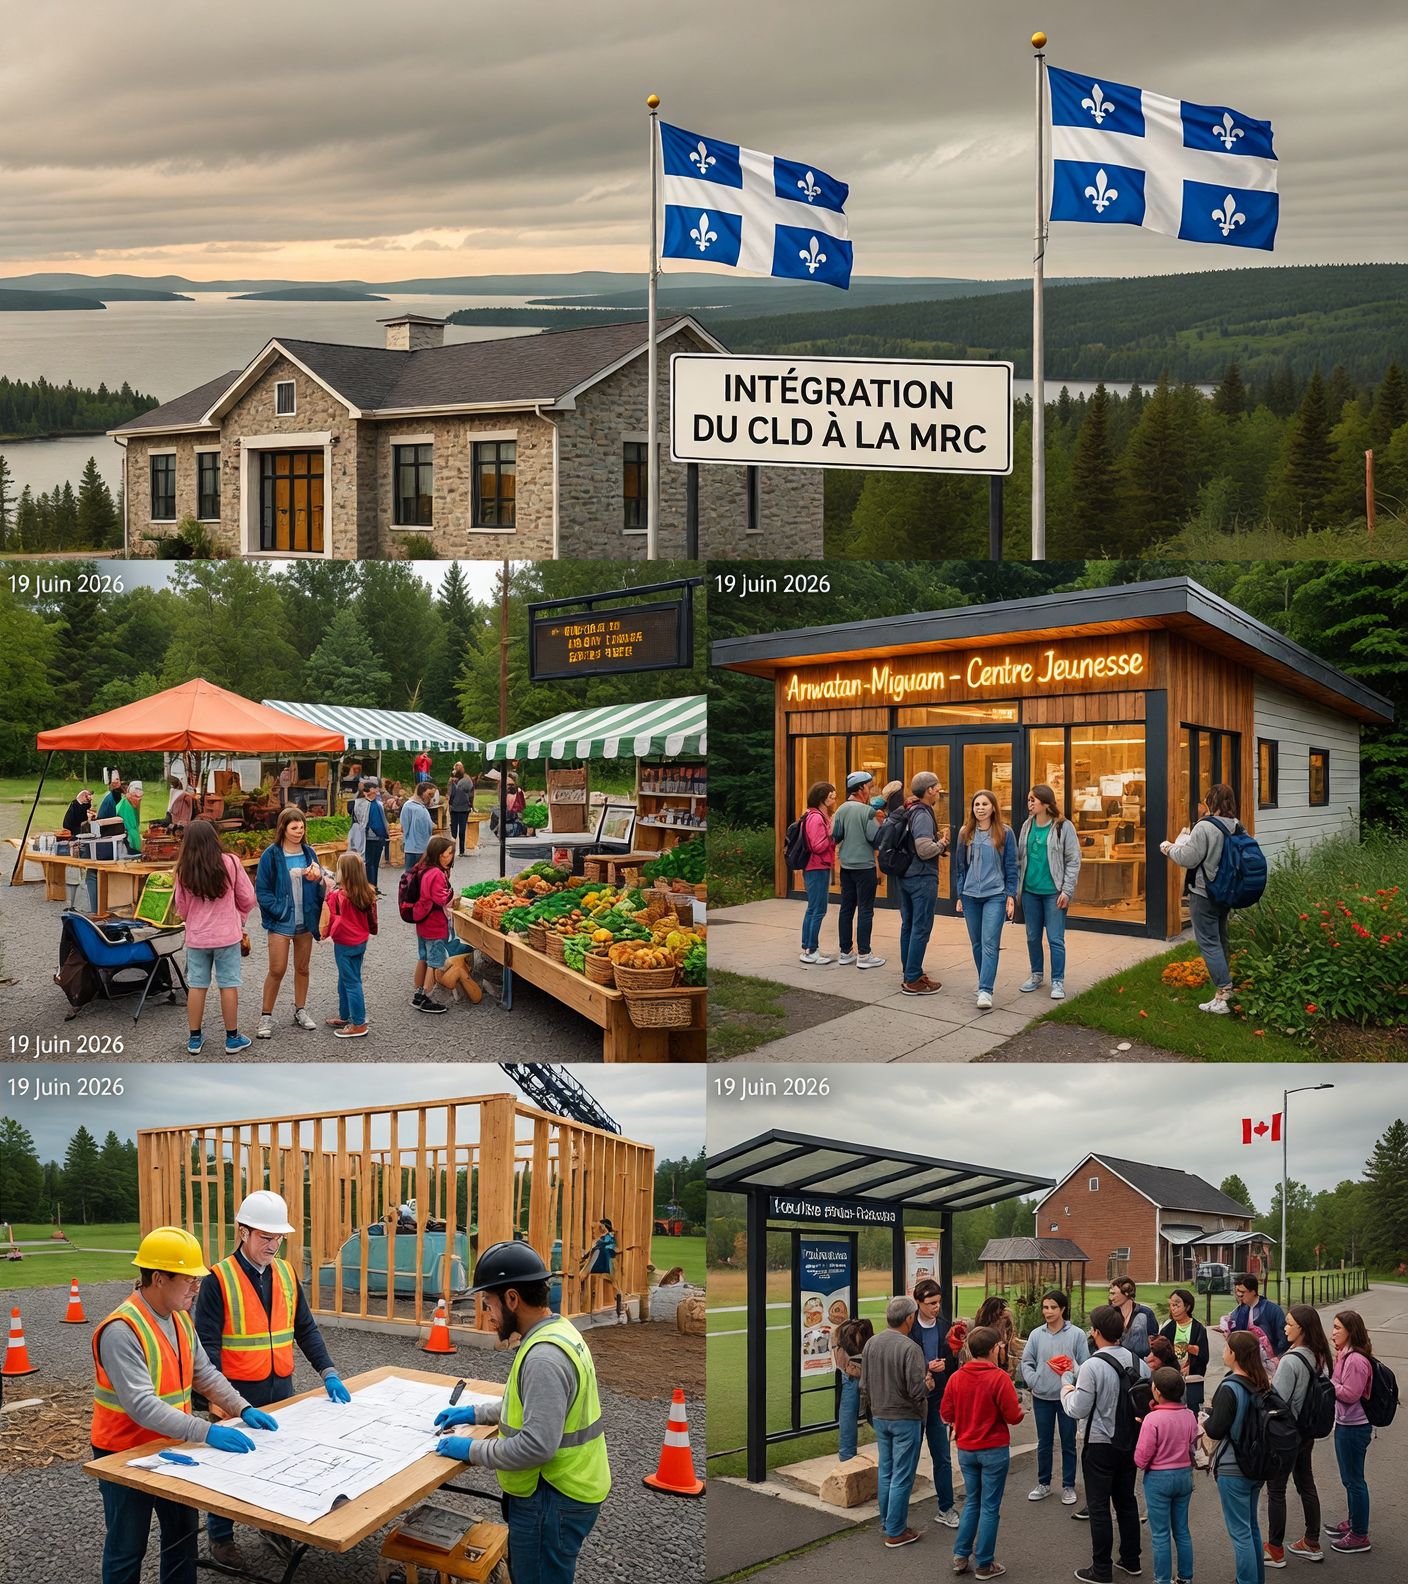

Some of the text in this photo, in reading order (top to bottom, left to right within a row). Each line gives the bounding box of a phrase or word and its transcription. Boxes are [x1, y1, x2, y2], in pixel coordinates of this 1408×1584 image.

[724, 368, 953, 410] INTÉGRATION
[693, 411, 987, 454] DU CLD À LA MRC
[966, 657, 1033, 689] Centre
[1037, 650, 1144, 683] Jeunesse
